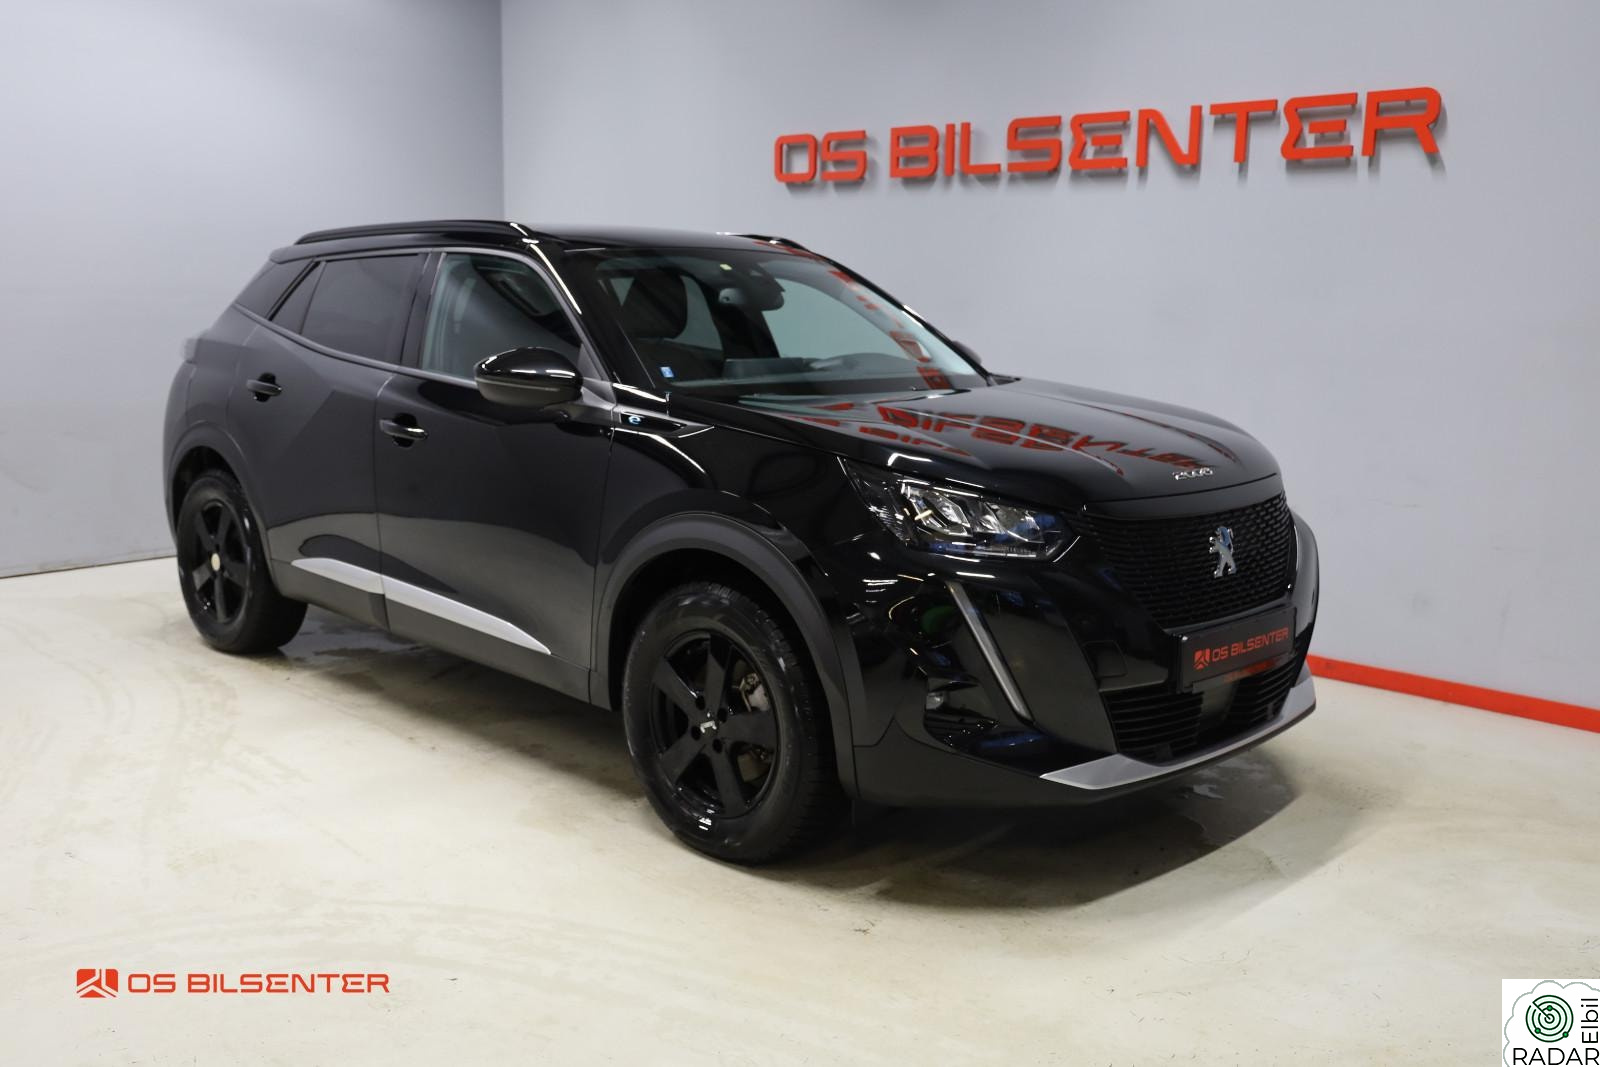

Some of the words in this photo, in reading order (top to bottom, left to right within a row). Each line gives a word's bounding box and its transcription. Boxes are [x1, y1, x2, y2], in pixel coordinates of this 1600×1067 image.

[774, 131, 868, 183] OS
[889, 86, 1442, 178] BILSENTER
[1211, 647, 1229, 662] OS
[1231, 627, 1289, 656] BILSENTER
